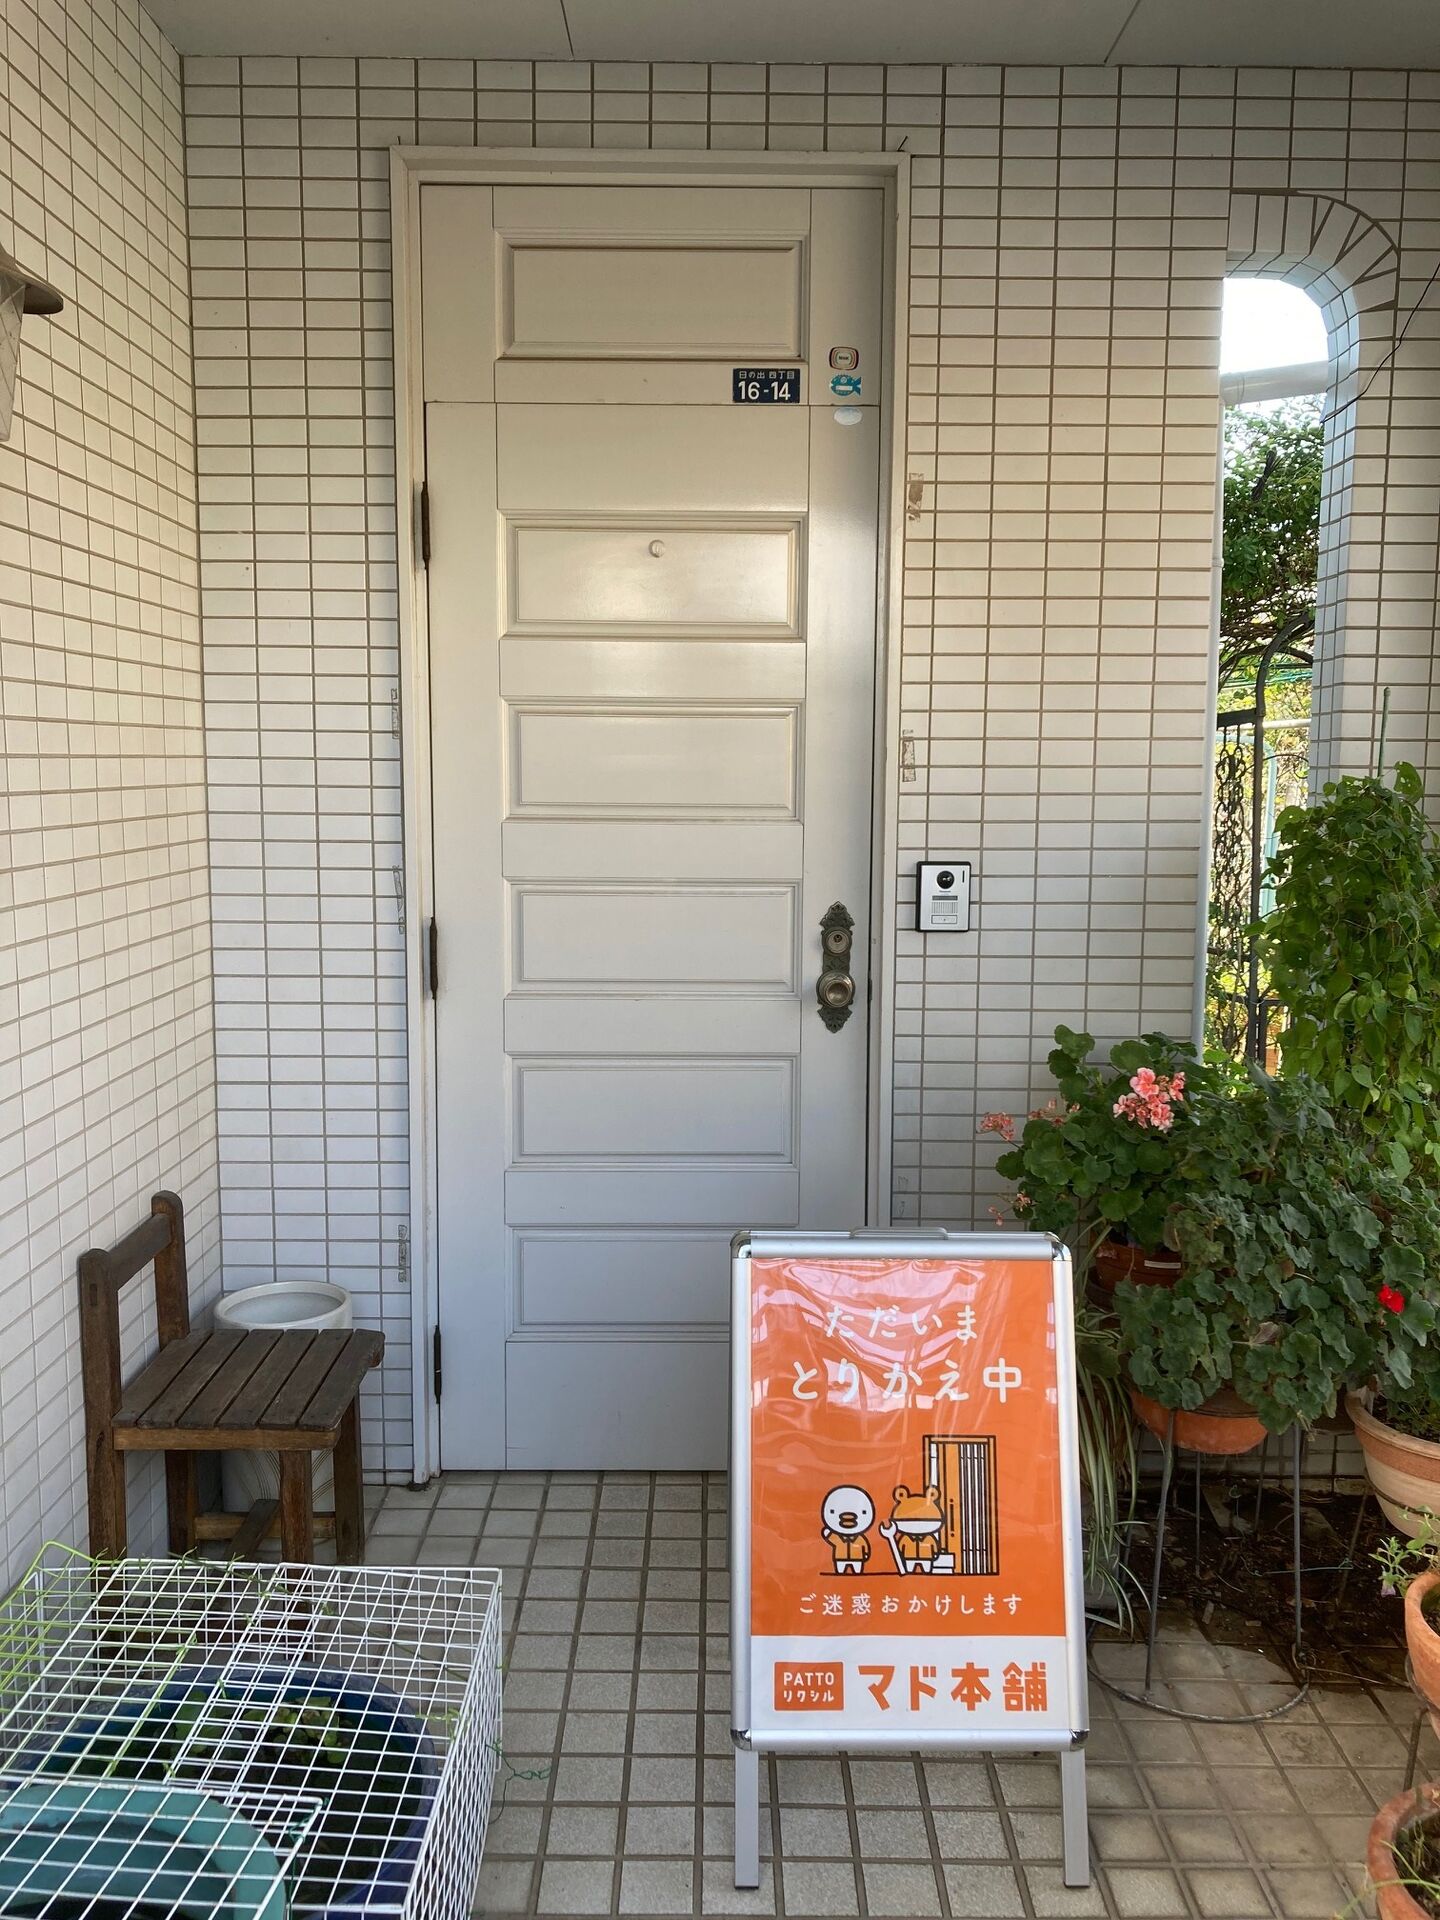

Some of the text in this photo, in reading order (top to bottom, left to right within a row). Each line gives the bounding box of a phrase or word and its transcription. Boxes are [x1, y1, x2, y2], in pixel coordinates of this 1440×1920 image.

[738, 380, 791, 400] 16-14
[827, 1304, 977, 1345] ただいま
[792, 1357, 1022, 1403] とりかえ中
[799, 1592, 1022, 1616] ご迷惑おかけします
[783, 1671, 835, 1686] PATTO
[857, 1661, 1048, 1712] マド本舗
[783, 1688, 835, 1703] リクシル
